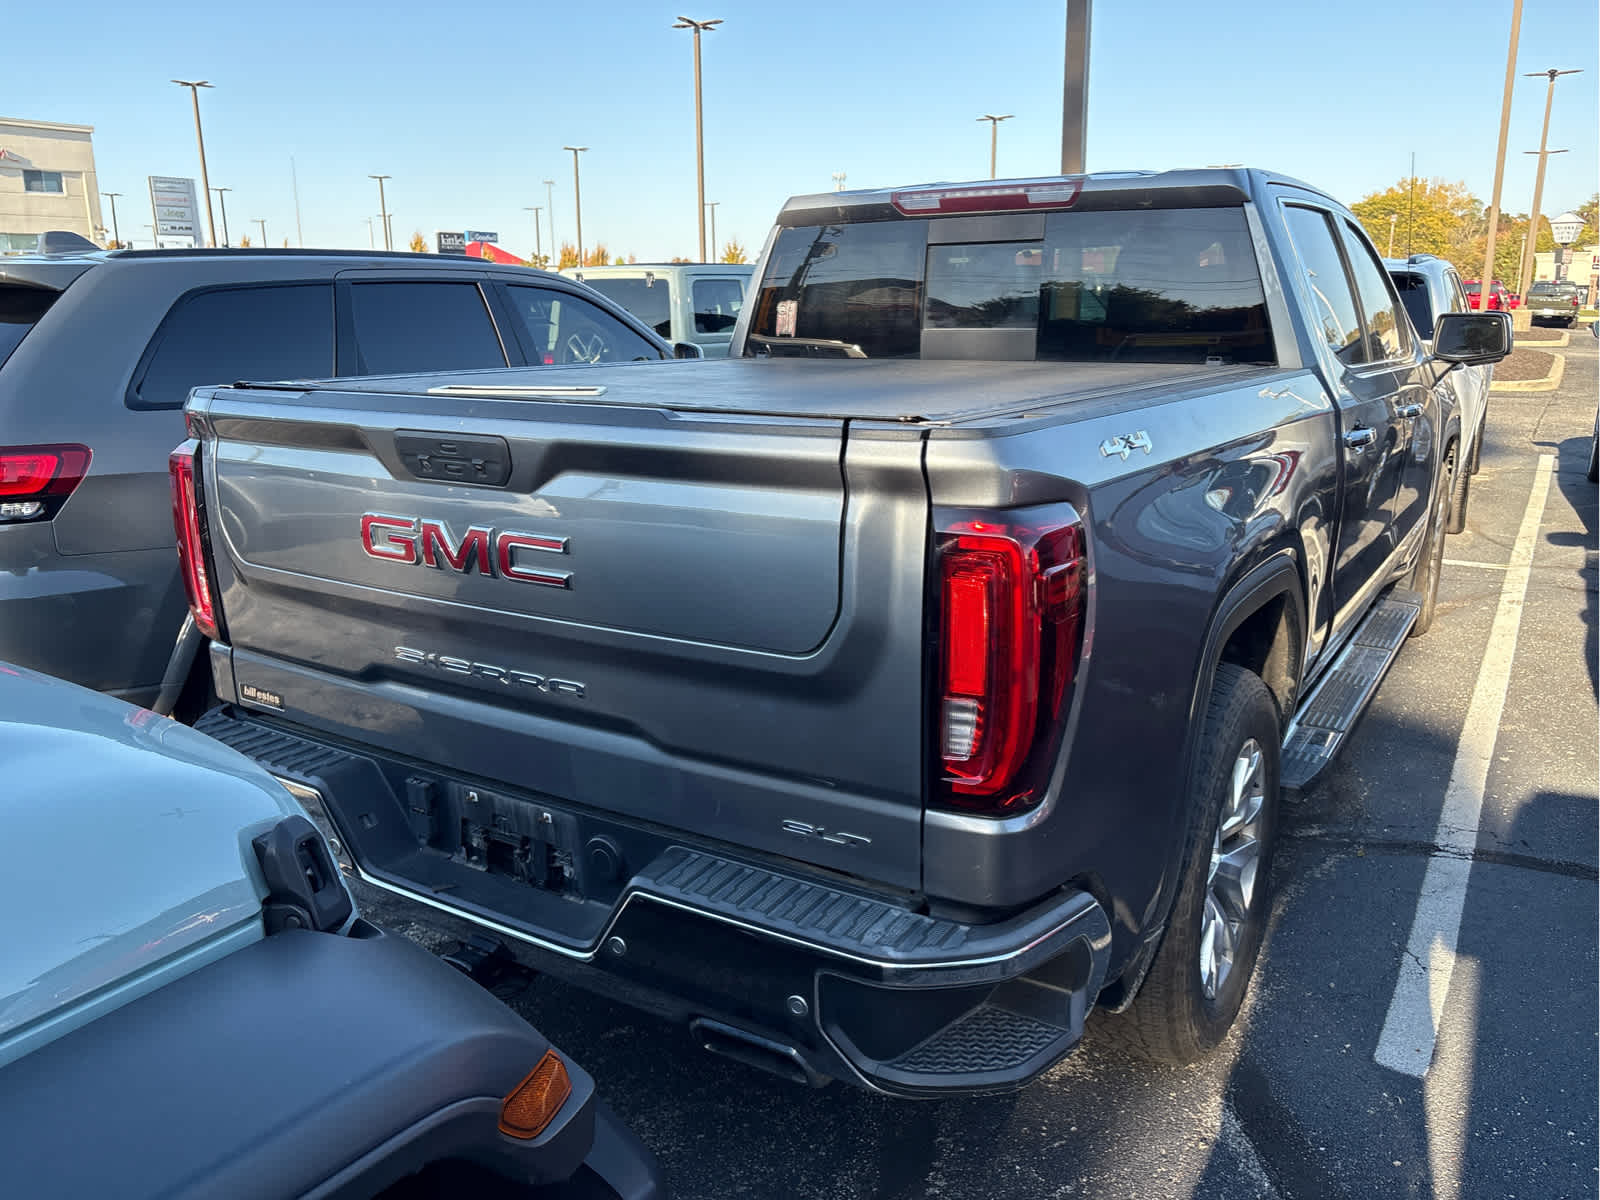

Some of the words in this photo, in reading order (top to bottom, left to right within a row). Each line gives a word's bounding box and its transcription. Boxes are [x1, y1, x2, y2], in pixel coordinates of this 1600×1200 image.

[360, 511, 576, 591] GMC
[243, 685, 257, 698] bill
[394, 646, 586, 698] SIERRA
[782, 819, 872, 847] SLT
